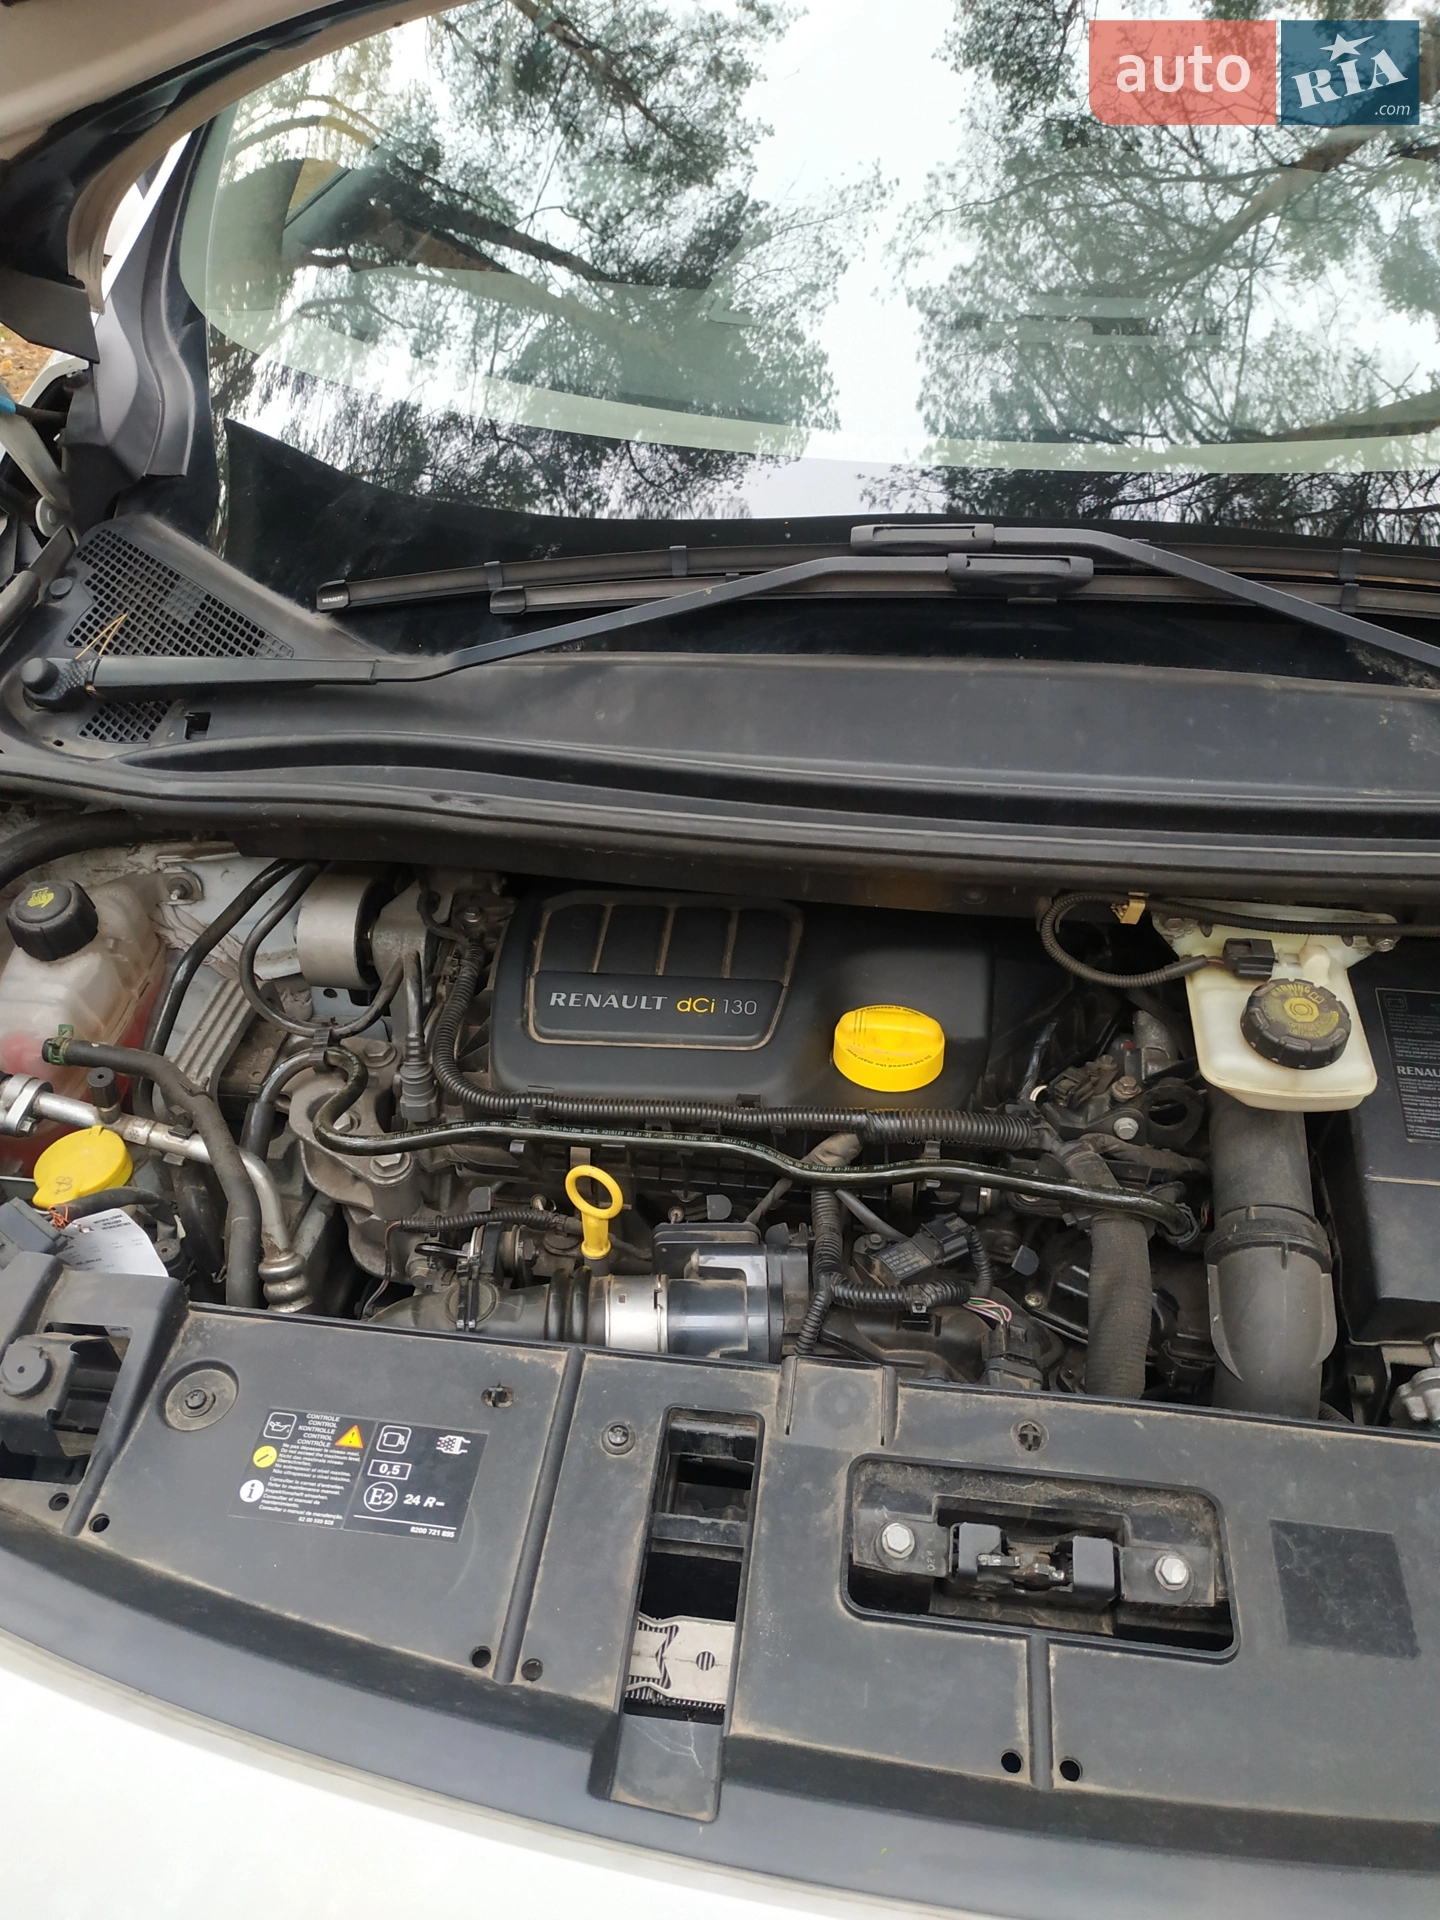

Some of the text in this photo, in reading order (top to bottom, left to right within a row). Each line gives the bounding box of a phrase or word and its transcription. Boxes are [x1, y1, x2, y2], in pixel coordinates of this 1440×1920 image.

[550, 992, 757, 1015] RENAULT dCi 130
[306, 1414, 340, 1422] CONTROLE
[298, 1426, 335, 1434] KONTROLLE
[378, 1464, 400, 1475] 0,5
[403, 1494, 421, 1506] 24
